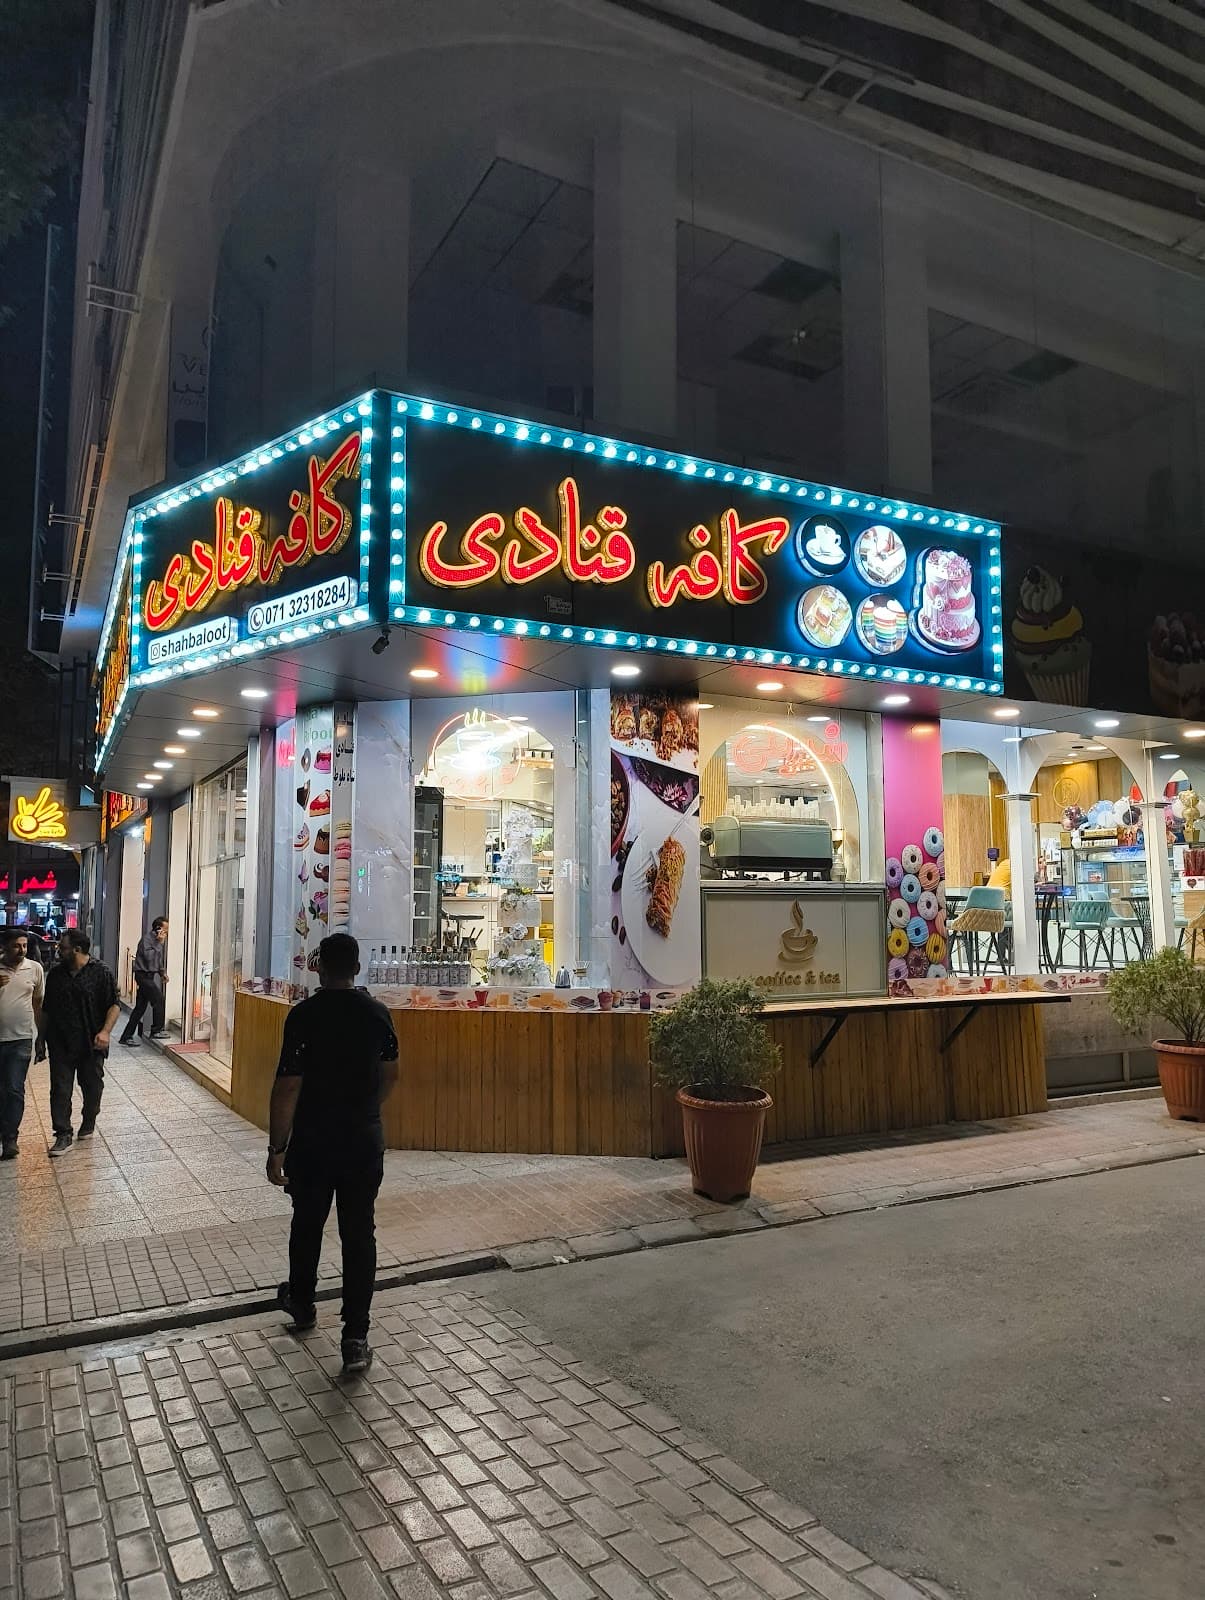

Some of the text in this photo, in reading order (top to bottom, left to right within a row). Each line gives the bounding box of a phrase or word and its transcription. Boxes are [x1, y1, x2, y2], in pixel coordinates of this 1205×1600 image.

[144, 431, 362, 631] کافه قنادی
[420, 476, 790, 608] کافه قنادی
[265, 582, 346, 625] 071 32318284
[161, 622, 228, 657] shahbaloot
[754, 971, 801, 987] coffee
[805, 970, 816, 984] &
